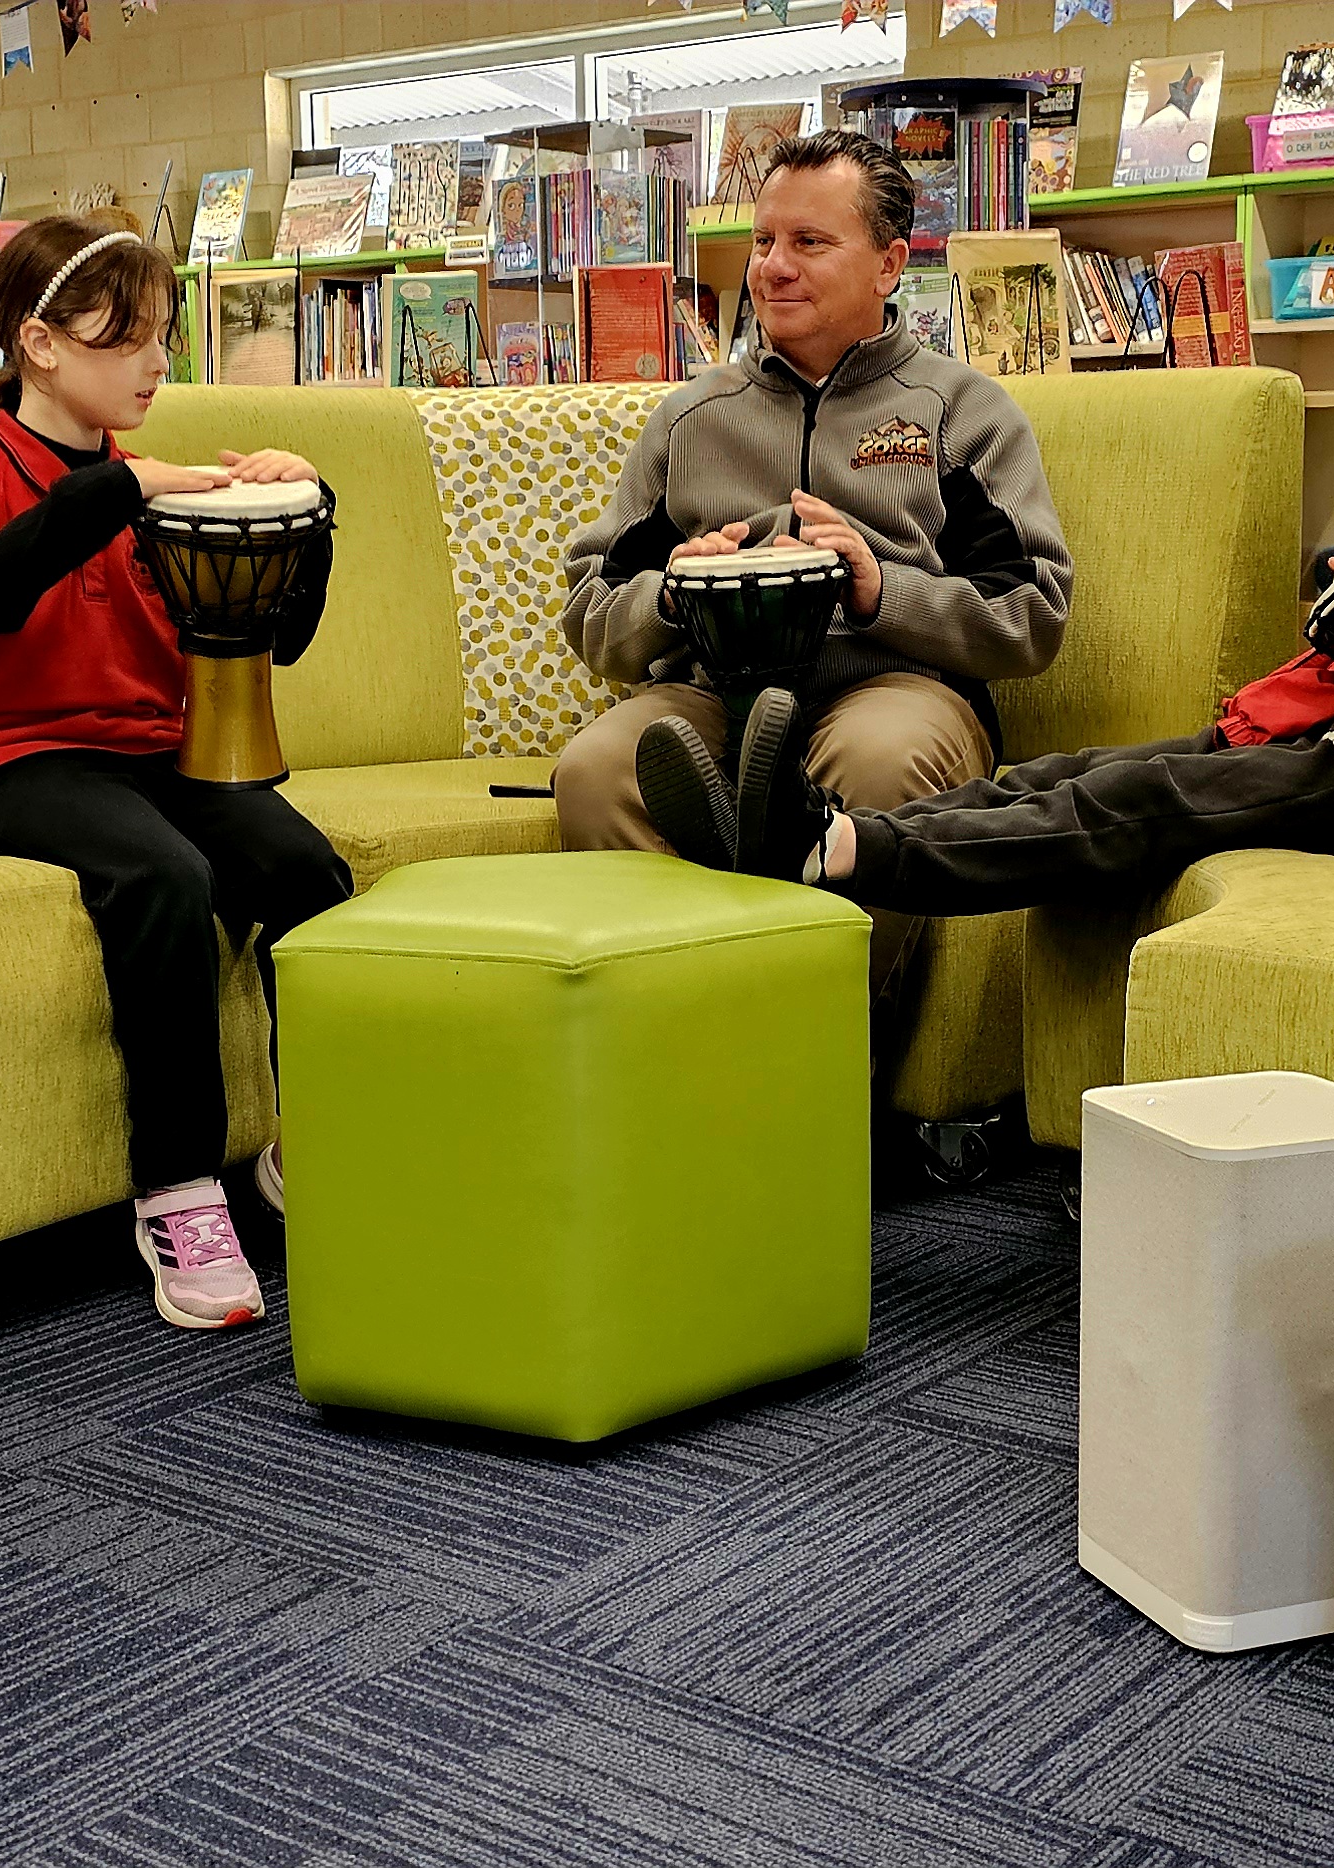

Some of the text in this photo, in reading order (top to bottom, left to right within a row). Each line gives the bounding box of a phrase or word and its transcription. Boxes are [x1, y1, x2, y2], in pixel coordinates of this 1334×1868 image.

[903, 127, 939, 136] GRAPHIC
[1286, 143, 1313, 153] ODER
[1117, 162, 1204, 181] THE RED TREE
[1231, 287, 1246, 351] INKHEART
[857, 436, 929, 457] GORGE
[850, 453, 934, 471] UNDERGROUND
